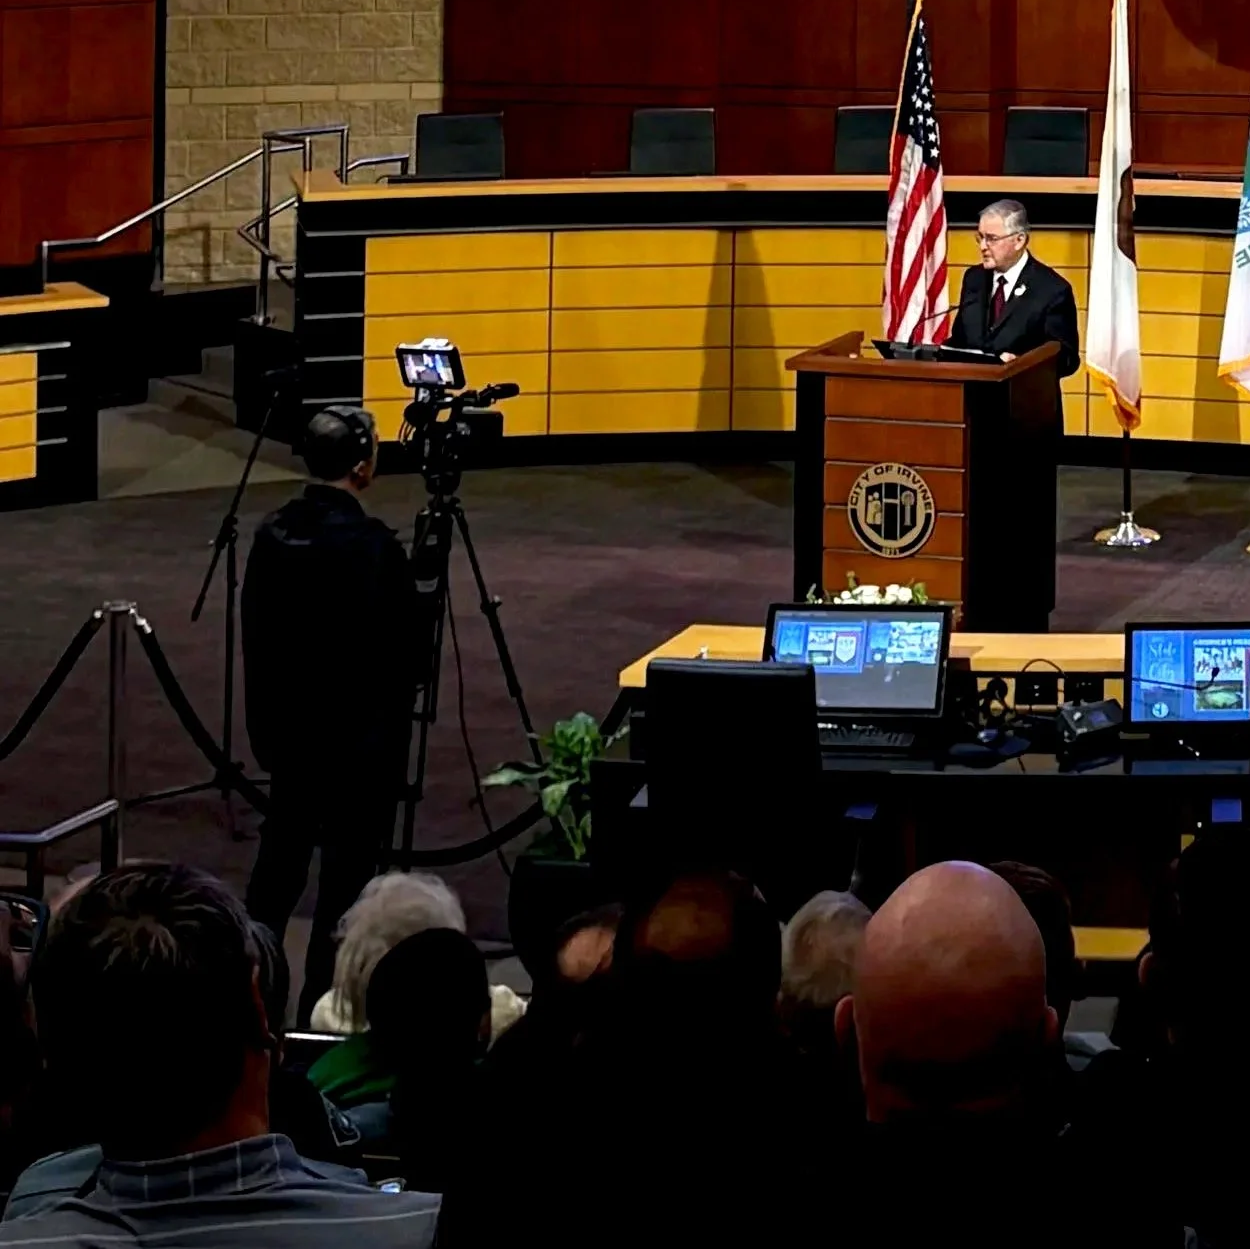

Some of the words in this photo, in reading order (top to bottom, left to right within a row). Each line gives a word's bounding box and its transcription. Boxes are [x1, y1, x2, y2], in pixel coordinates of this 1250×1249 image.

[850, 474, 870, 506] CITY
[874, 465, 894, 476] OF
[897, 467, 932, 511] IRVINE
